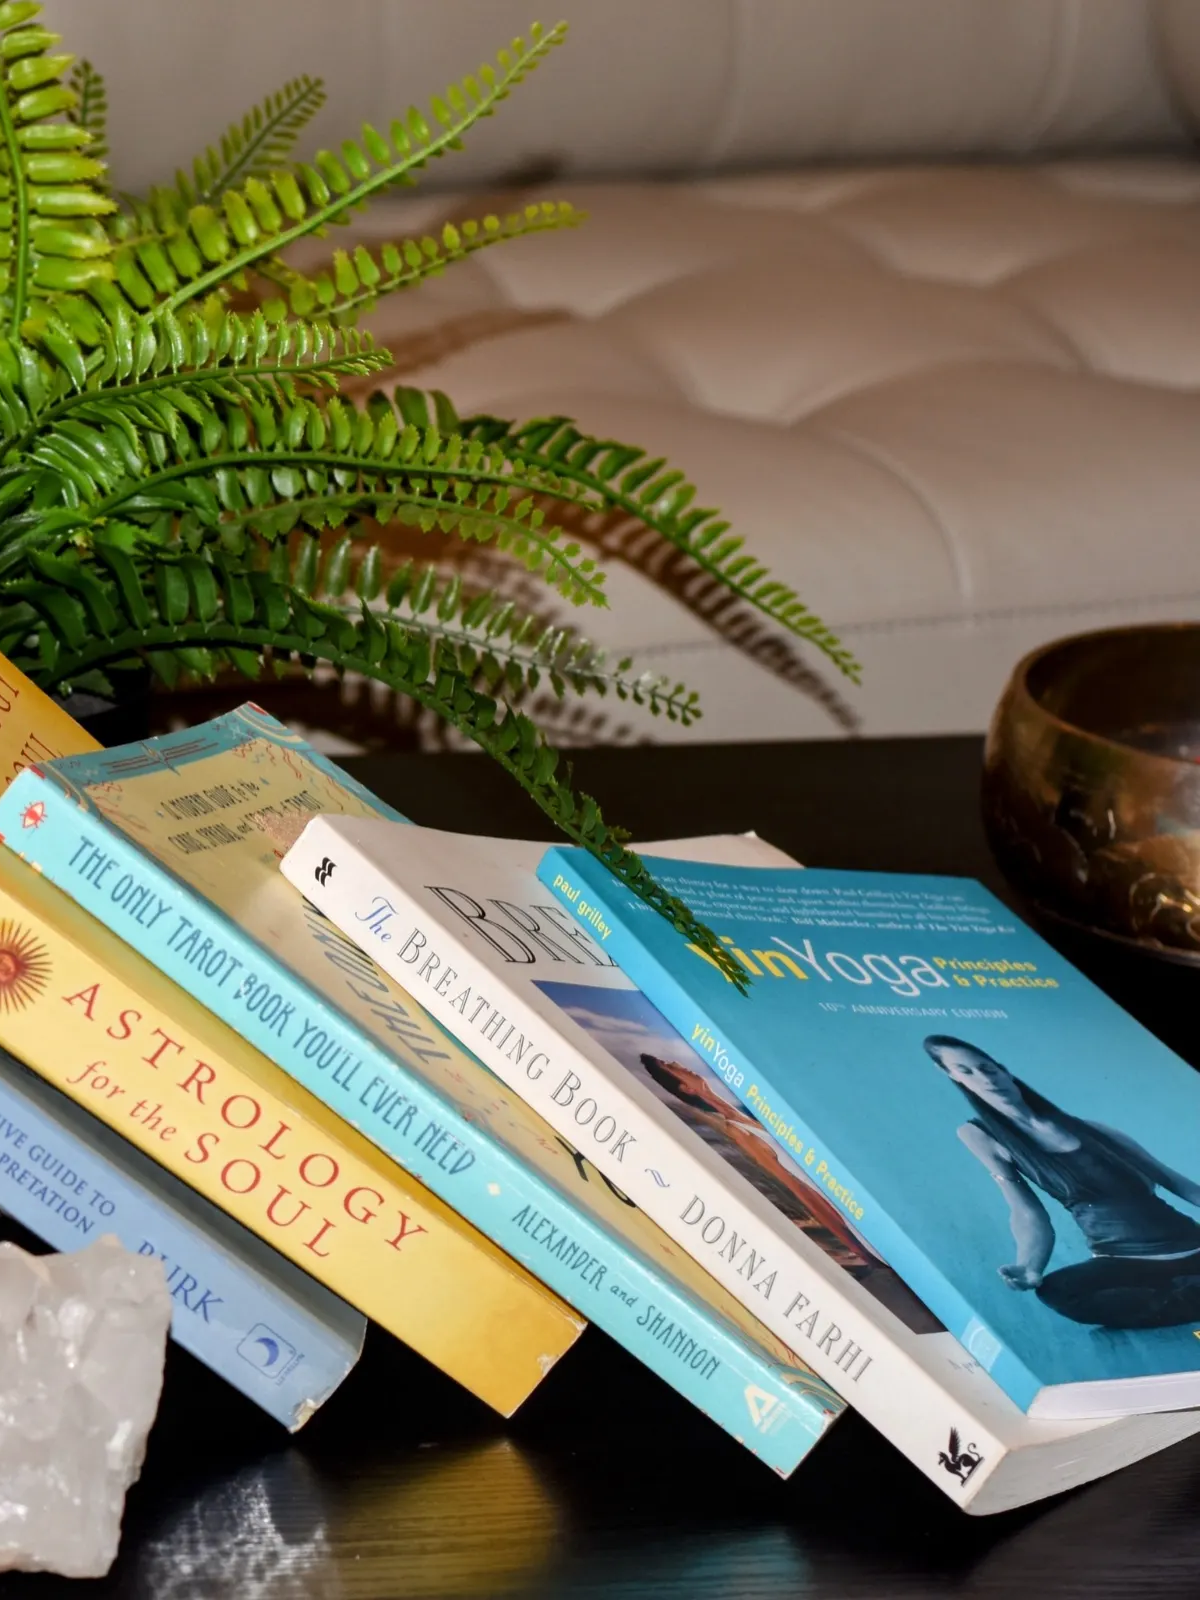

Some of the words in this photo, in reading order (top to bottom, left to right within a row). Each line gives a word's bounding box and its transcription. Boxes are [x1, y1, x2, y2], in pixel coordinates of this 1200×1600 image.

[553, 873, 578, 904] paul
[577, 898, 613, 941] grilley
[932, 956, 1037, 974] Principles
[67, 835, 121, 891] THE
[109, 873, 173, 930] ONLY
[165, 914, 243, 988] TAROT
[234, 971, 297, 1039] BOOK
[292, 1016, 363, 1092] YOU'LL
[358, 1075, 418, 1137] EVER
[413, 1119, 476, 1176] NEED
[851, 1003, 948, 1018] ANNIVERSARY
[950, 1007, 1009, 1020] EDITION
[952, 974, 971, 988] &
[972, 975, 1060, 989] Practice
[27, 1144, 89, 1196] GUIDE
[89, 1189, 116, 1217] TO
[63, 982, 429, 1252] ASTROLOGY
[66, 1060, 127, 1100] for
[129, 1096, 178, 1142] the
[184, 1132, 337, 1259] SOUL
[355, 896, 400, 943] The
[396, 927, 552, 1083] BREATHING
[550, 1070, 638, 1164] BOOK
[679, 1194, 780, 1301] DONNA
[783, 1291, 875, 1384] FARHI
[746, 1085, 804, 1154] Principles
[804, 1148, 816, 1166] &
[815, 1160, 865, 1221] Practice
[510, 1204, 609, 1293] ALEXANDER
[609, 1283, 639, 1309] and
[635, 1304, 721, 1381] SHANNON
